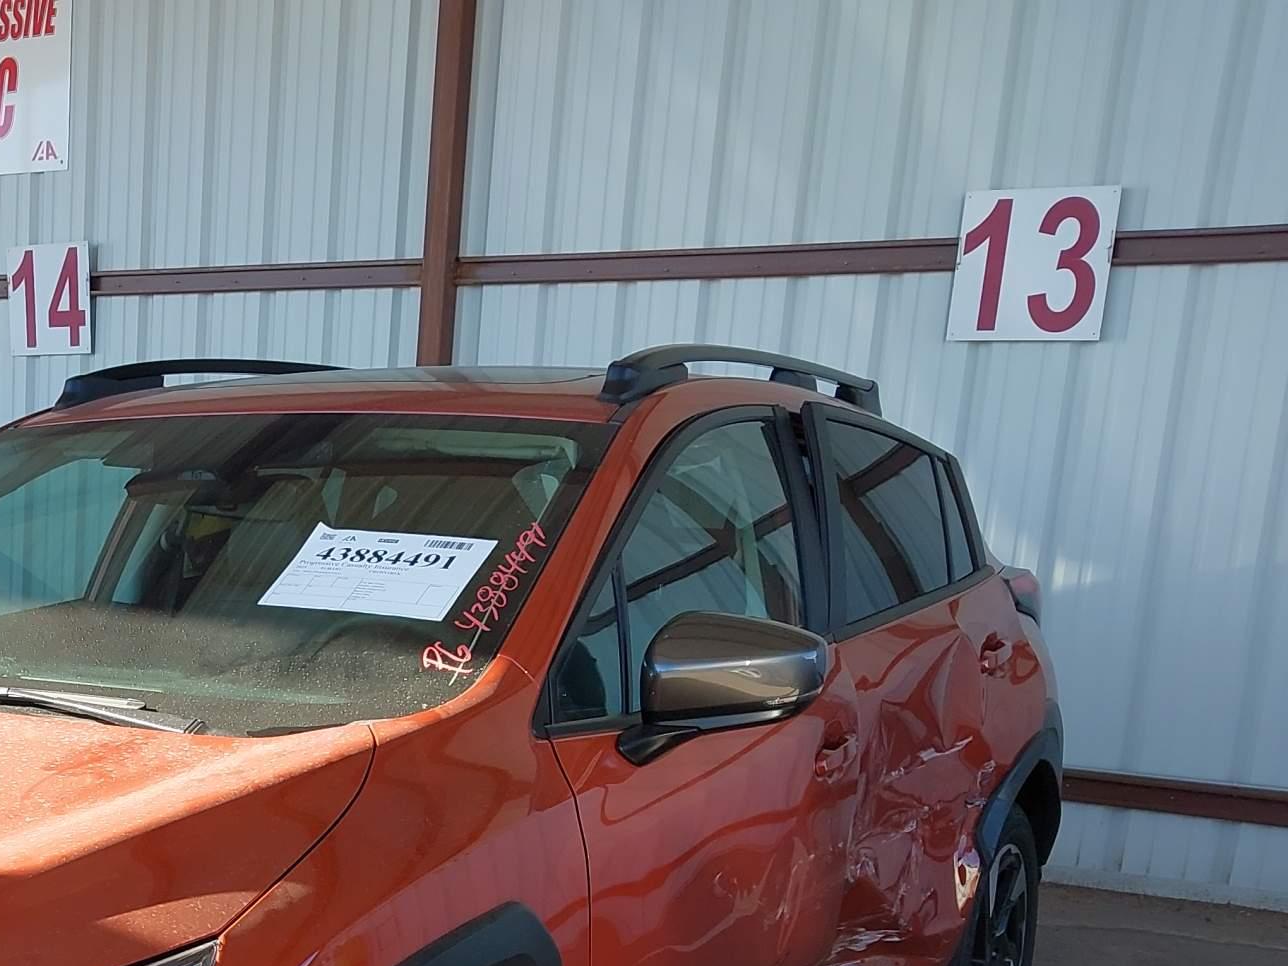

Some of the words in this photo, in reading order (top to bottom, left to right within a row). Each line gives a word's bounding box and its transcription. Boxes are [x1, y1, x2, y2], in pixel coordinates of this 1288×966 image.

[10, 246, 87, 349] 14
[962, 195, 1101, 333] 13
[315, 546, 457, 570] 43884491
